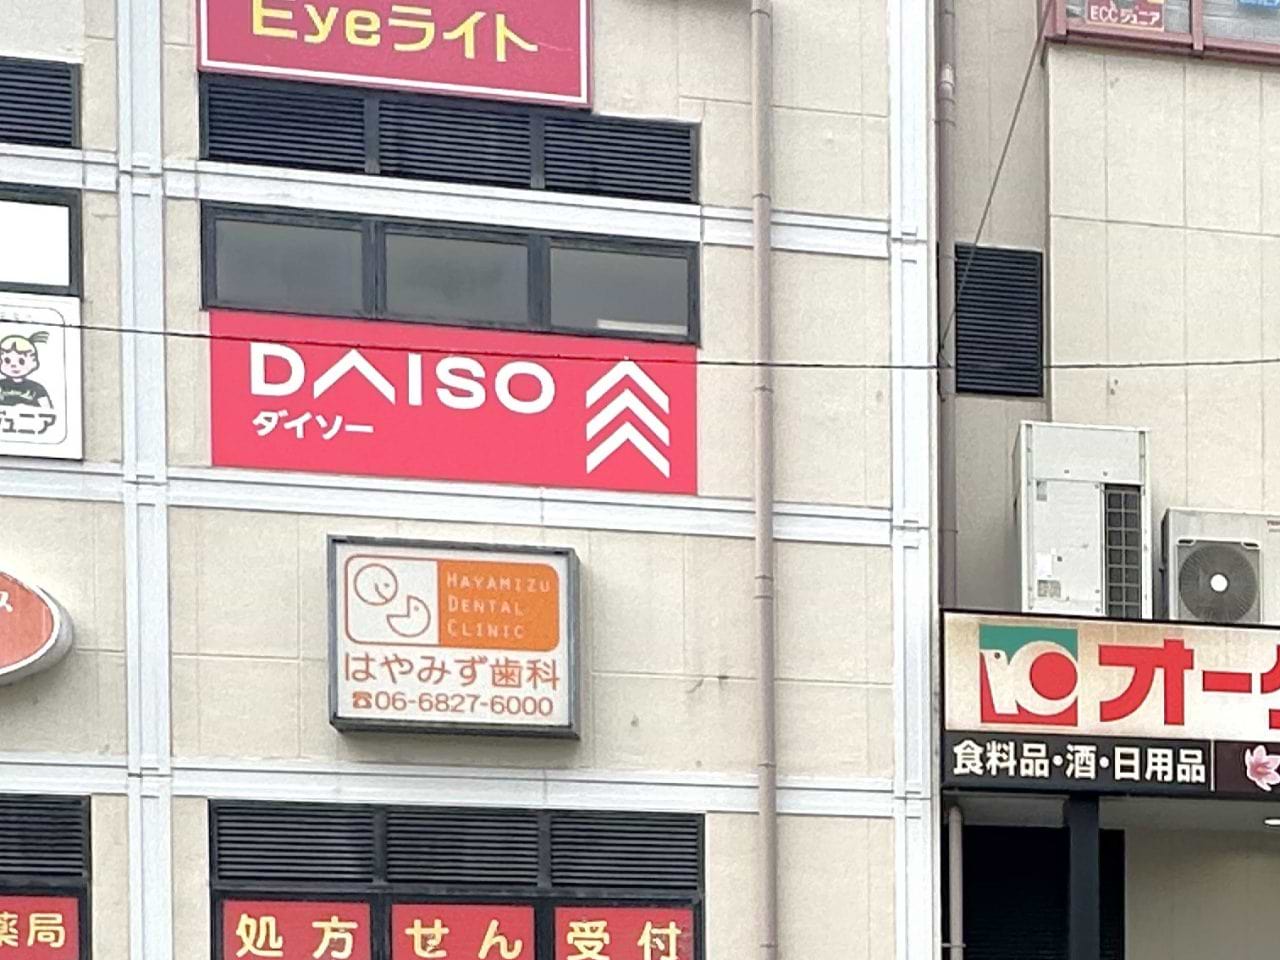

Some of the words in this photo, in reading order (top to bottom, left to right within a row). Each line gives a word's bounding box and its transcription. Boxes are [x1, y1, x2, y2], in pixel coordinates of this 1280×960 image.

[1090, 5, 1160, 26] ECCジュニア
[249, 342, 557, 414] DAISO
[0, 410, 57, 435] ュニア
[251, 409, 374, 440] ダイソー
[446, 571, 550, 593] HAYAMIZU
[448, 594, 524, 617] DENTAL
[447, 621, 525, 640] CLINIC
[344, 651, 561, 691] はやみず歯科
[374, 690, 554, 717] 06-6827-6000
[952, 739, 1206, 783] 食料品・酒・日用品
